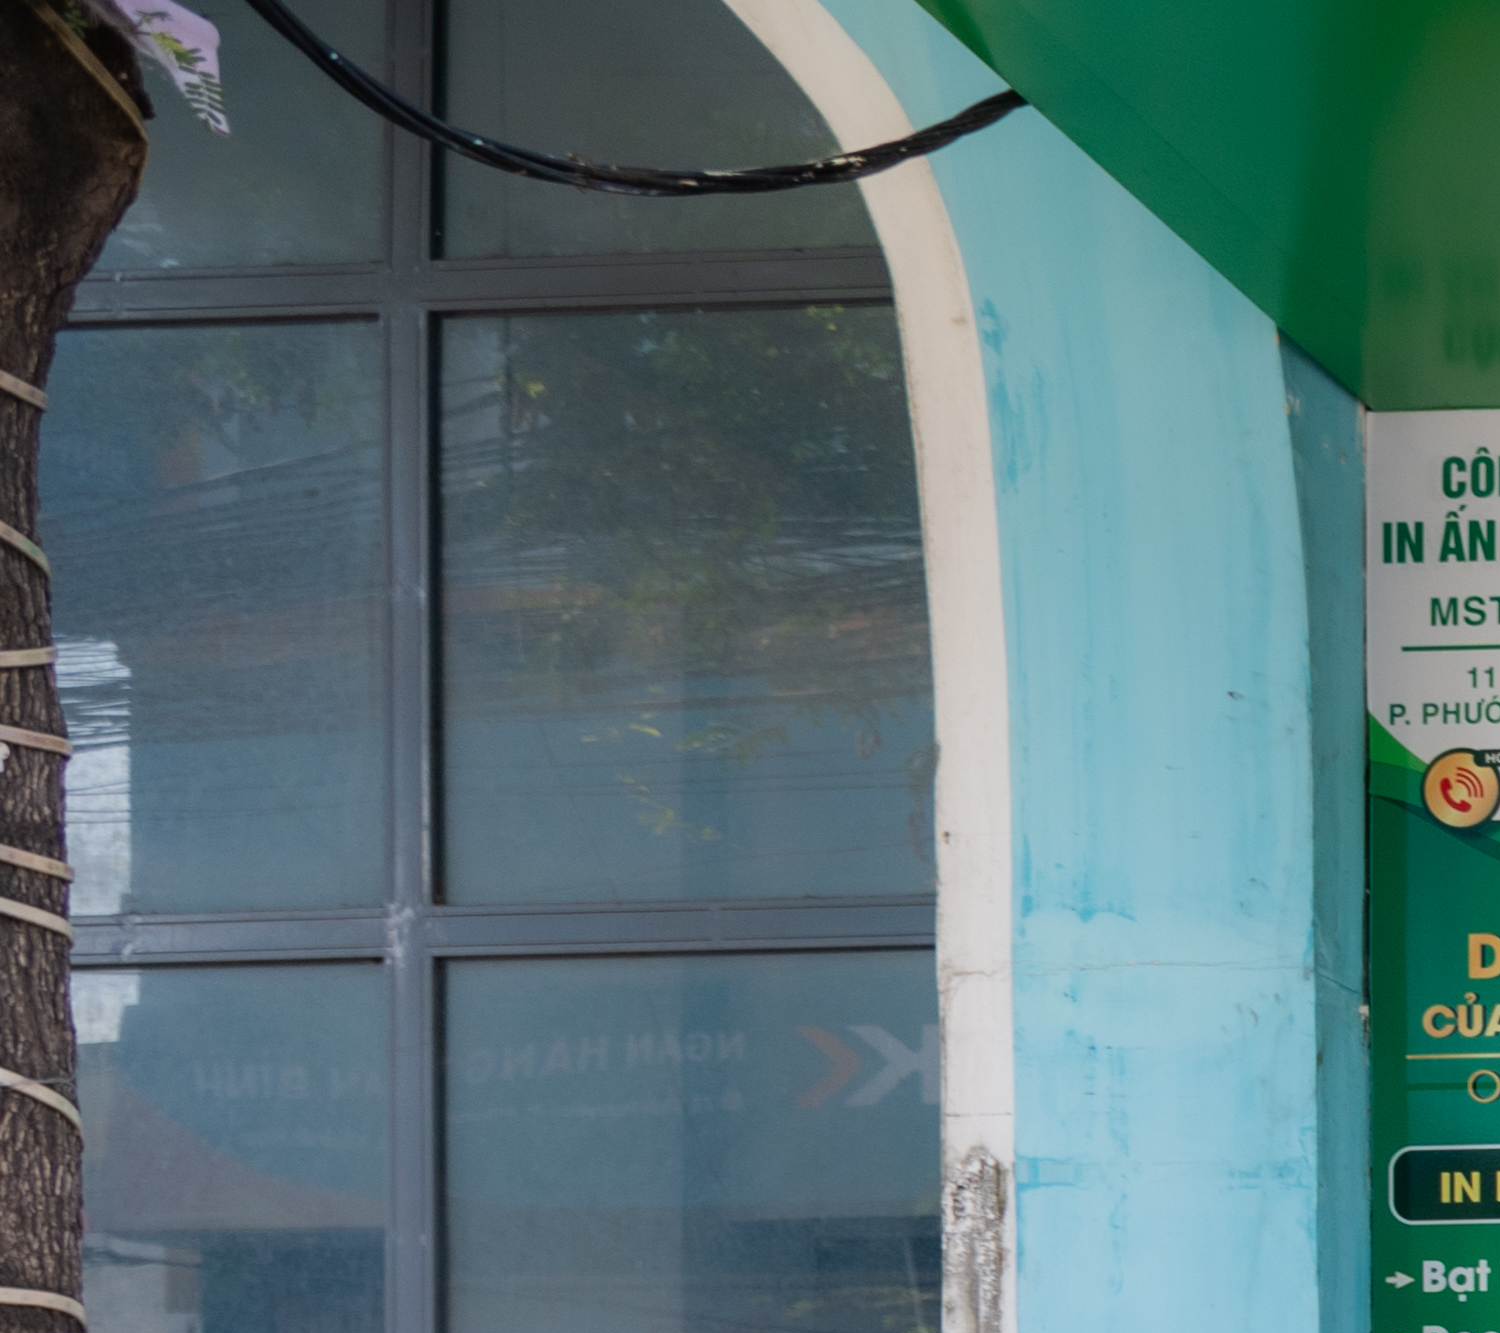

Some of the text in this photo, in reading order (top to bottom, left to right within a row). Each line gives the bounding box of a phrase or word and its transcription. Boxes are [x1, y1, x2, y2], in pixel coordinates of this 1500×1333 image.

[1383, 521, 1424, 564] IN
[1440, 505, 1496, 562] ẤN
[1468, 667, 1495, 687] 11
[1390, 704, 1411, 724] P.
[1441, 1171, 1480, 1203] IN
[1422, 1259, 1490, 1301] Bạt
